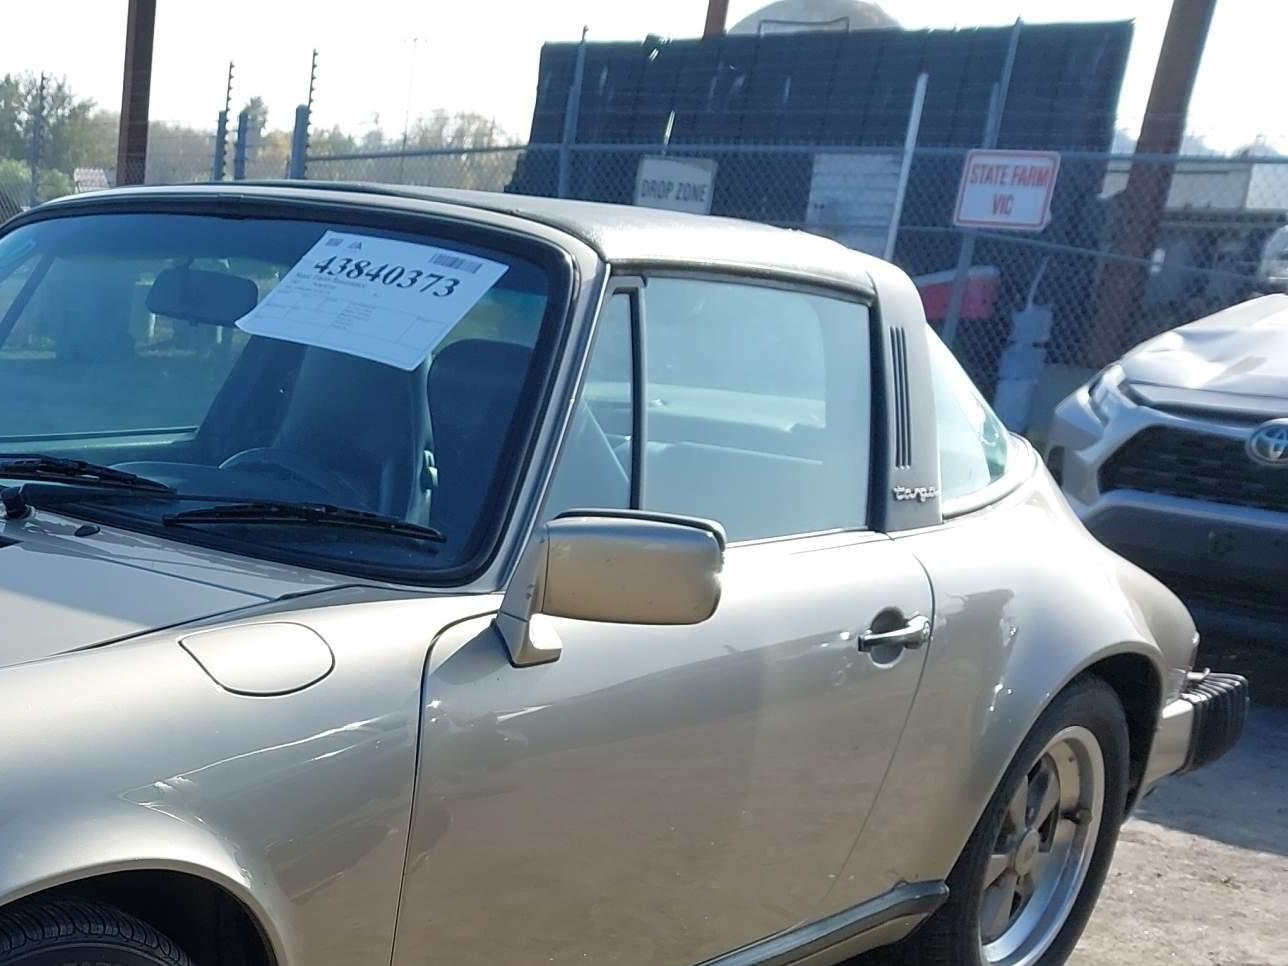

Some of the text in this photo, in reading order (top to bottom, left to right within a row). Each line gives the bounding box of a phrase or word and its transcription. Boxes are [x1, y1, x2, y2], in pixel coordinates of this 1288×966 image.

[970, 163, 1050, 188] STATE FARM
[640, 179, 707, 202] DROP ZONE
[993, 192, 1015, 215] VIC
[314, 255, 461, 297] 43840373
